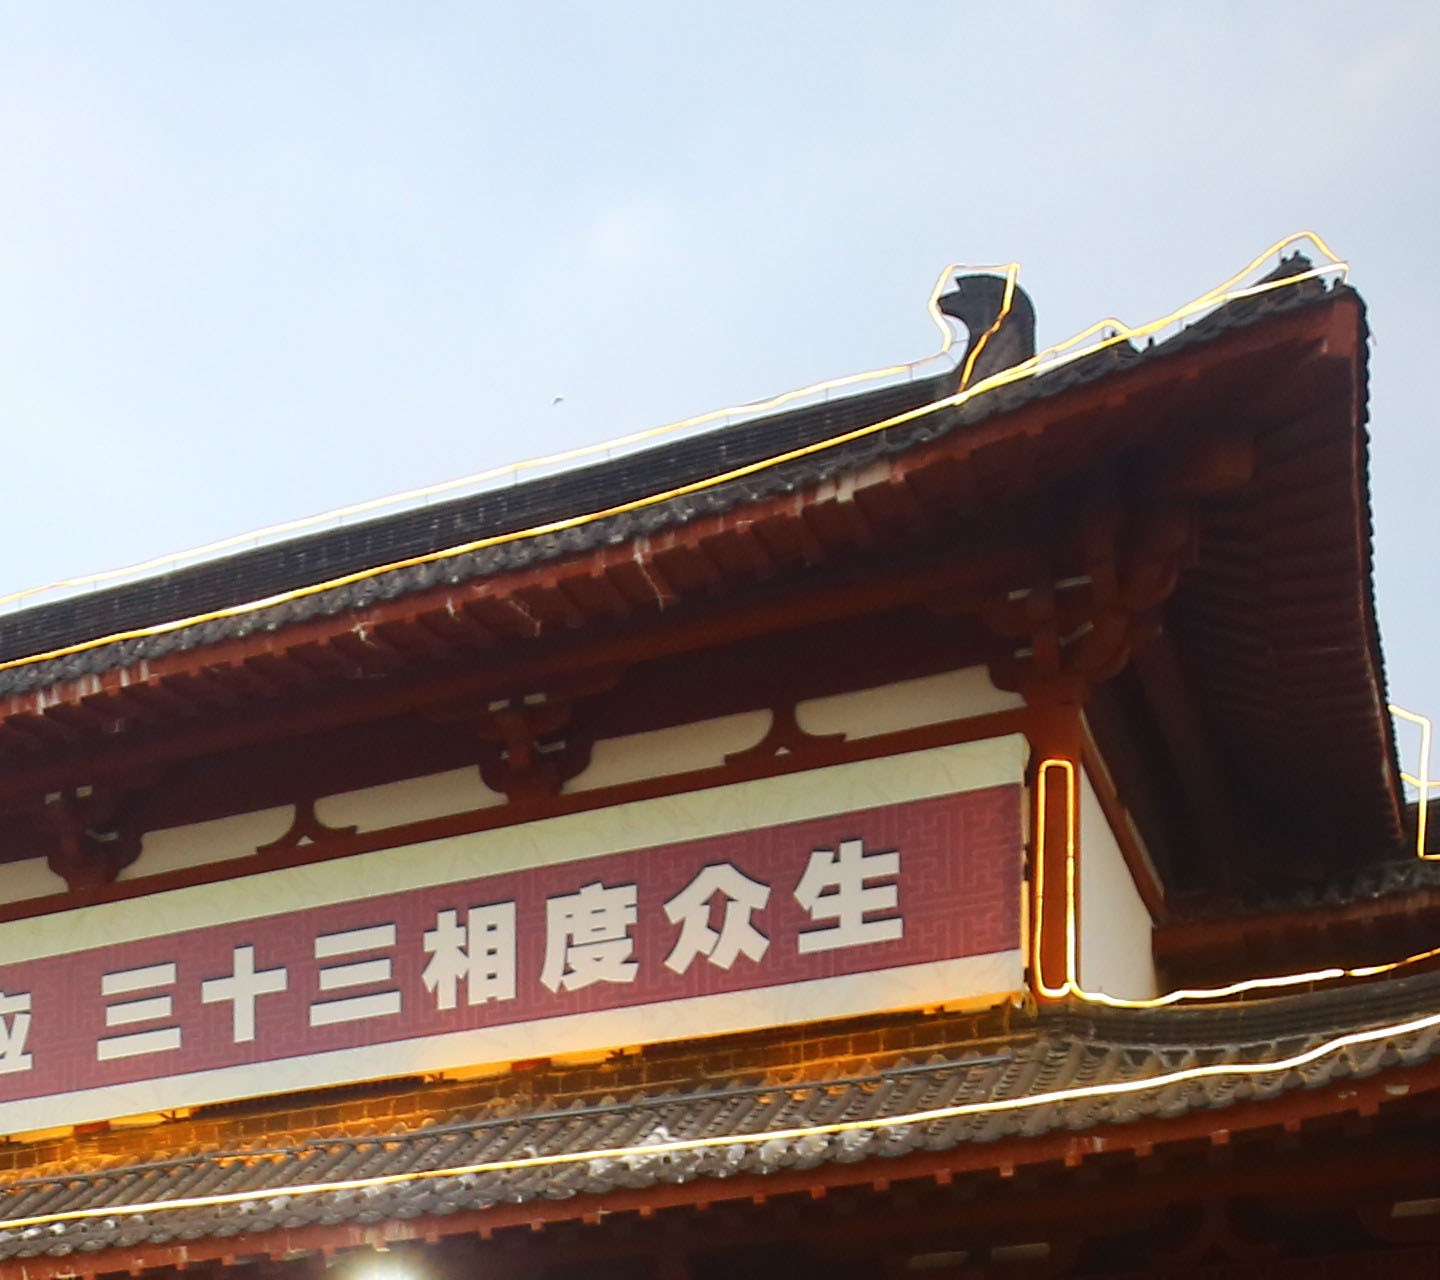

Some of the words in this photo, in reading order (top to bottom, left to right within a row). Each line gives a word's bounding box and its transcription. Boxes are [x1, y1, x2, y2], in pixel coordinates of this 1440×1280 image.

[95, 838, 906, 1062] 三十三相度众生
